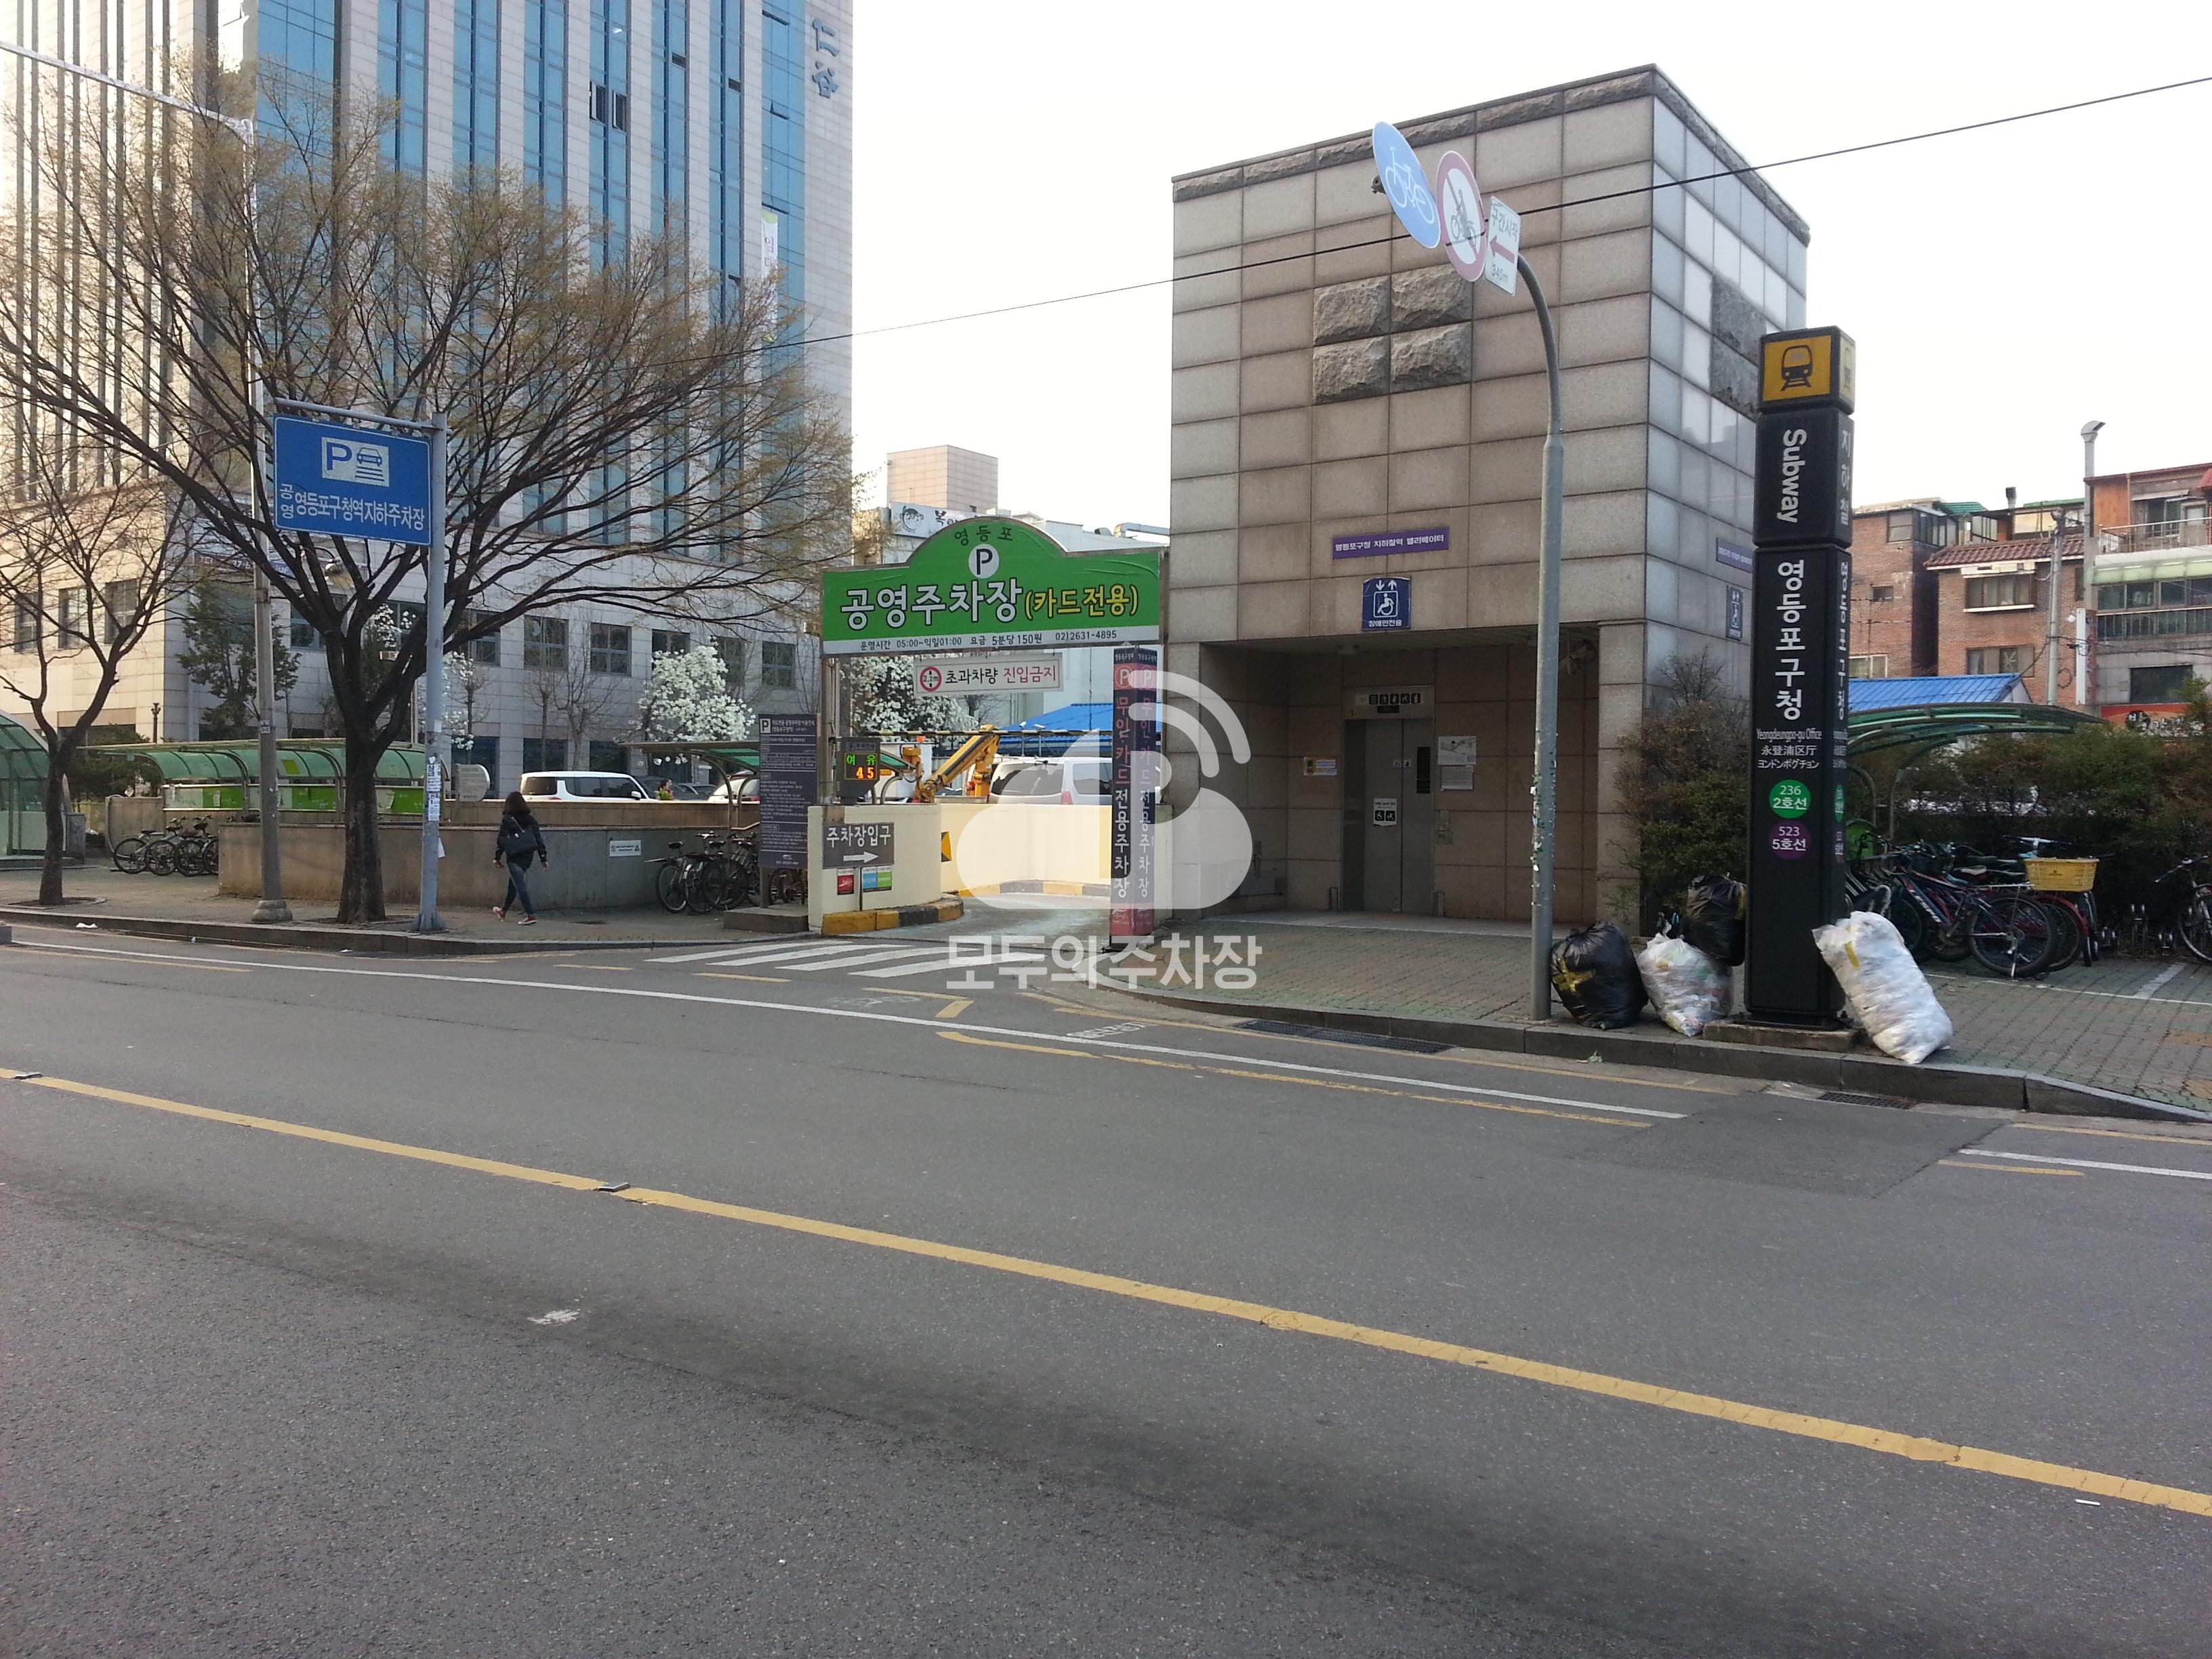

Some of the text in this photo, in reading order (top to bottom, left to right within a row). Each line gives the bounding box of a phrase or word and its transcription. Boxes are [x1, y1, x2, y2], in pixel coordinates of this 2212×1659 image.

[326, 442, 352, 470] P
[1777, 428, 1807, 523] Subway
[1840, 430, 1851, 526] 지하철
[295, 491, 425, 530] 영등포구청역지하주차장
[954, 525, 1014, 546] 영등포
[976, 549, 993, 575] P
[841, 577, 1139, 631] 공영주차장 (카드전용)
[860, 630, 1118, 651] 운영시간 05:00~익일01:00 요금 5분당 150원 02)2631-4895
[1775, 559, 1807, 720] 영등포구청
[1837, 561, 1849, 721] 영등포구청
[945, 665, 1056, 684] 초과차량 진입금지
[762, 720, 769, 732] P
[1757, 727, 1822, 743] Yeongdeungpo-gu Office
[1761, 745, 1818, 756] 永登浦区厅
[856, 766, 874, 779] 45
[1780, 785, 1801, 795] 236
[1773, 797, 1807, 811] 2호선
[826, 824, 892, 848] 주차장입구
[1778, 826, 1800, 836] 523
[1771, 838, 1807, 851] 5호선
